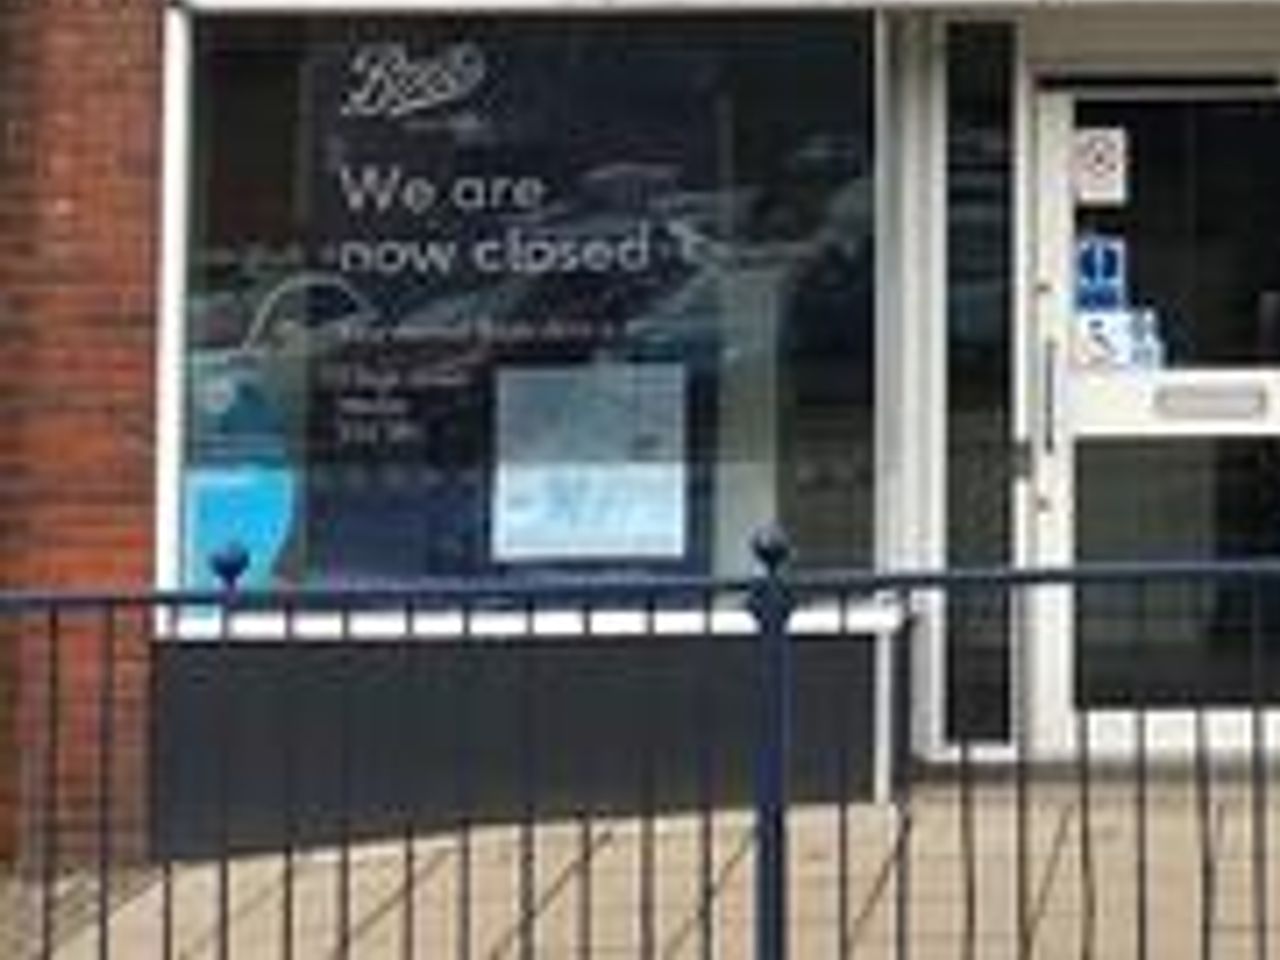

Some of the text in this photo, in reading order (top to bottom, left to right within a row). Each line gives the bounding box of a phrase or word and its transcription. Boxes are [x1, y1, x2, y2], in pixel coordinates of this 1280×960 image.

[340, 166, 544, 213] We are
[341, 222, 650, 272] now closed
